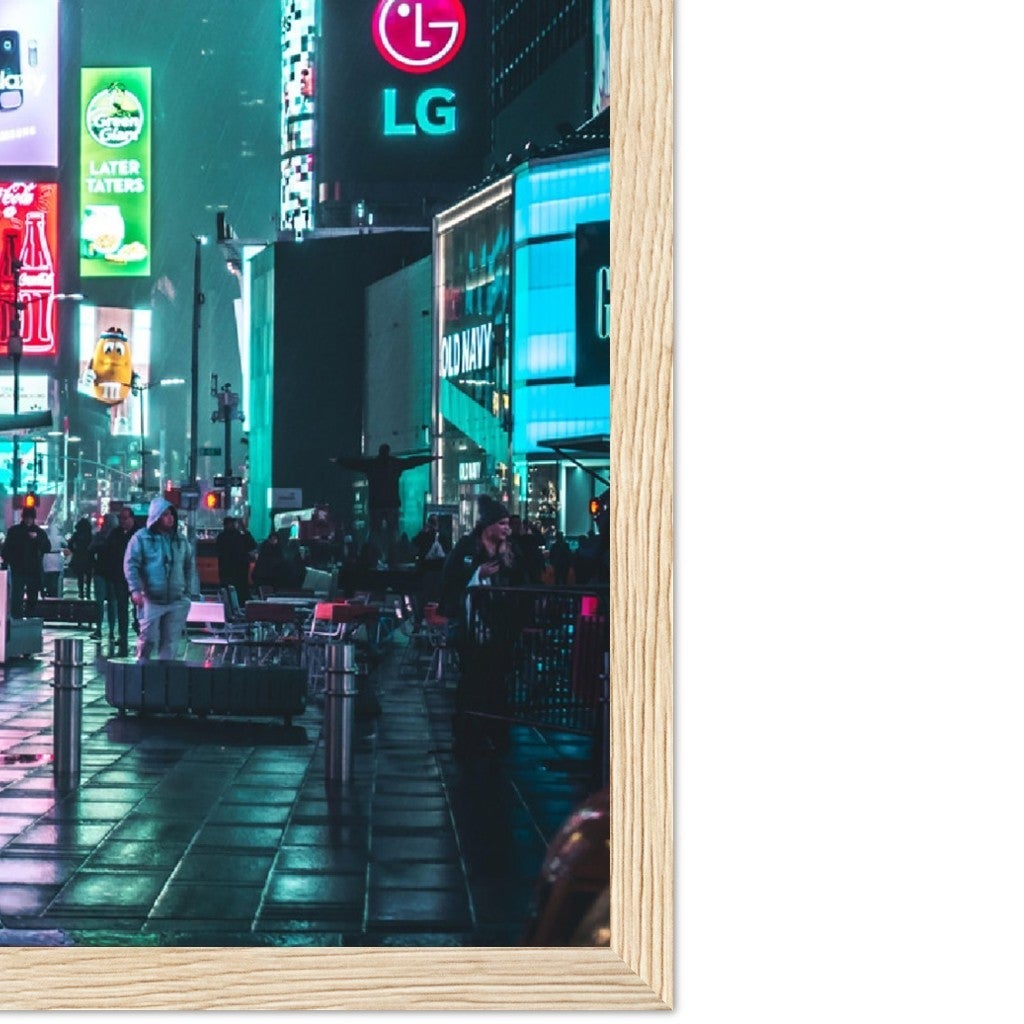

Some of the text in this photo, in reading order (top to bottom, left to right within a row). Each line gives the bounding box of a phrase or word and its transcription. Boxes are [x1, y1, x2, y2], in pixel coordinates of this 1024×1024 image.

[383, 87, 457, 136] LG
[89, 159, 141, 176] LATER
[85, 177, 145, 193] TATERS
[440, 322, 493, 378] OLD NAVY
